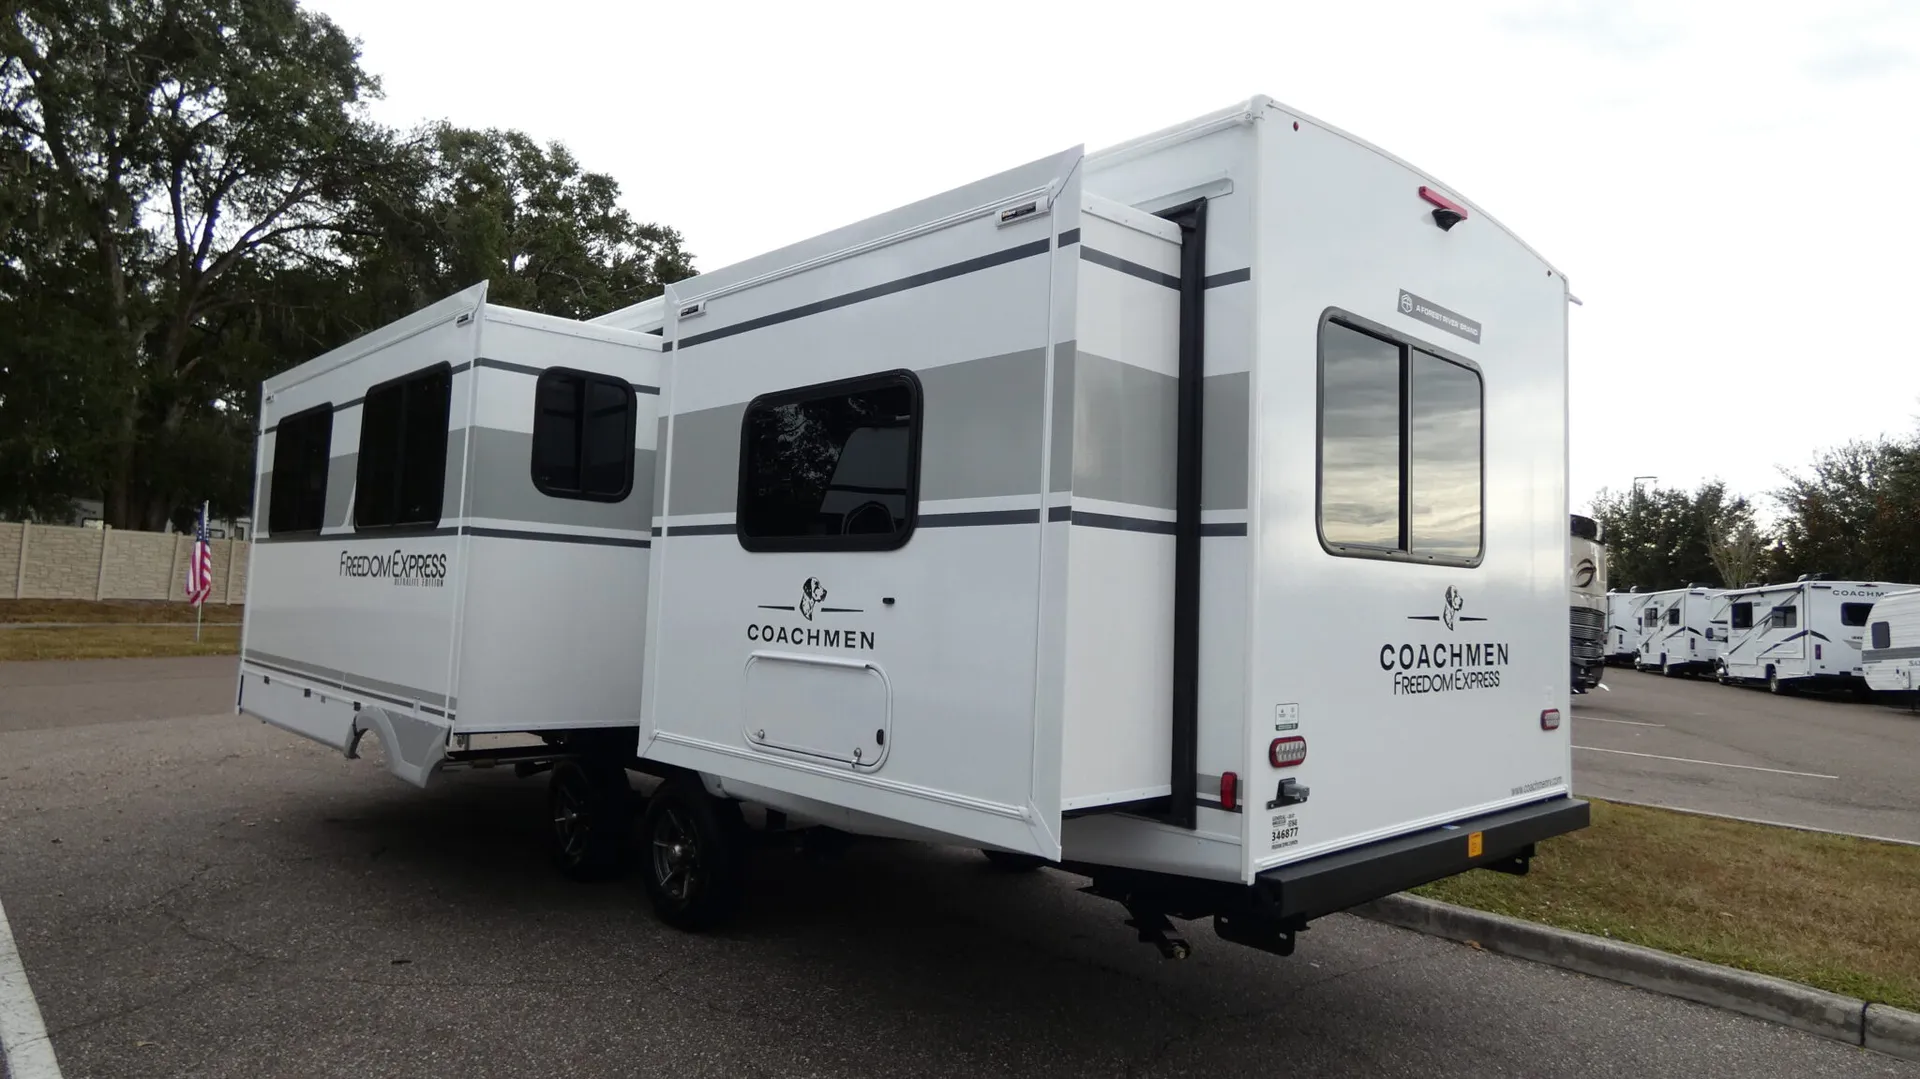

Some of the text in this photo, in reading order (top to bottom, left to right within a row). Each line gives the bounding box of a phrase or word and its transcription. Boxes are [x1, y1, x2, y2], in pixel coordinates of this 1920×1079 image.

[1421, 306, 1442, 322] FOREST
[1442, 315, 1459, 328] RIVER
[1832, 589, 1888, 597] COACHM
[747, 623, 875, 650] COACHMEN
[1379, 643, 1509, 671] COACHMEN
[1271, 826, 1299, 841] 346877
